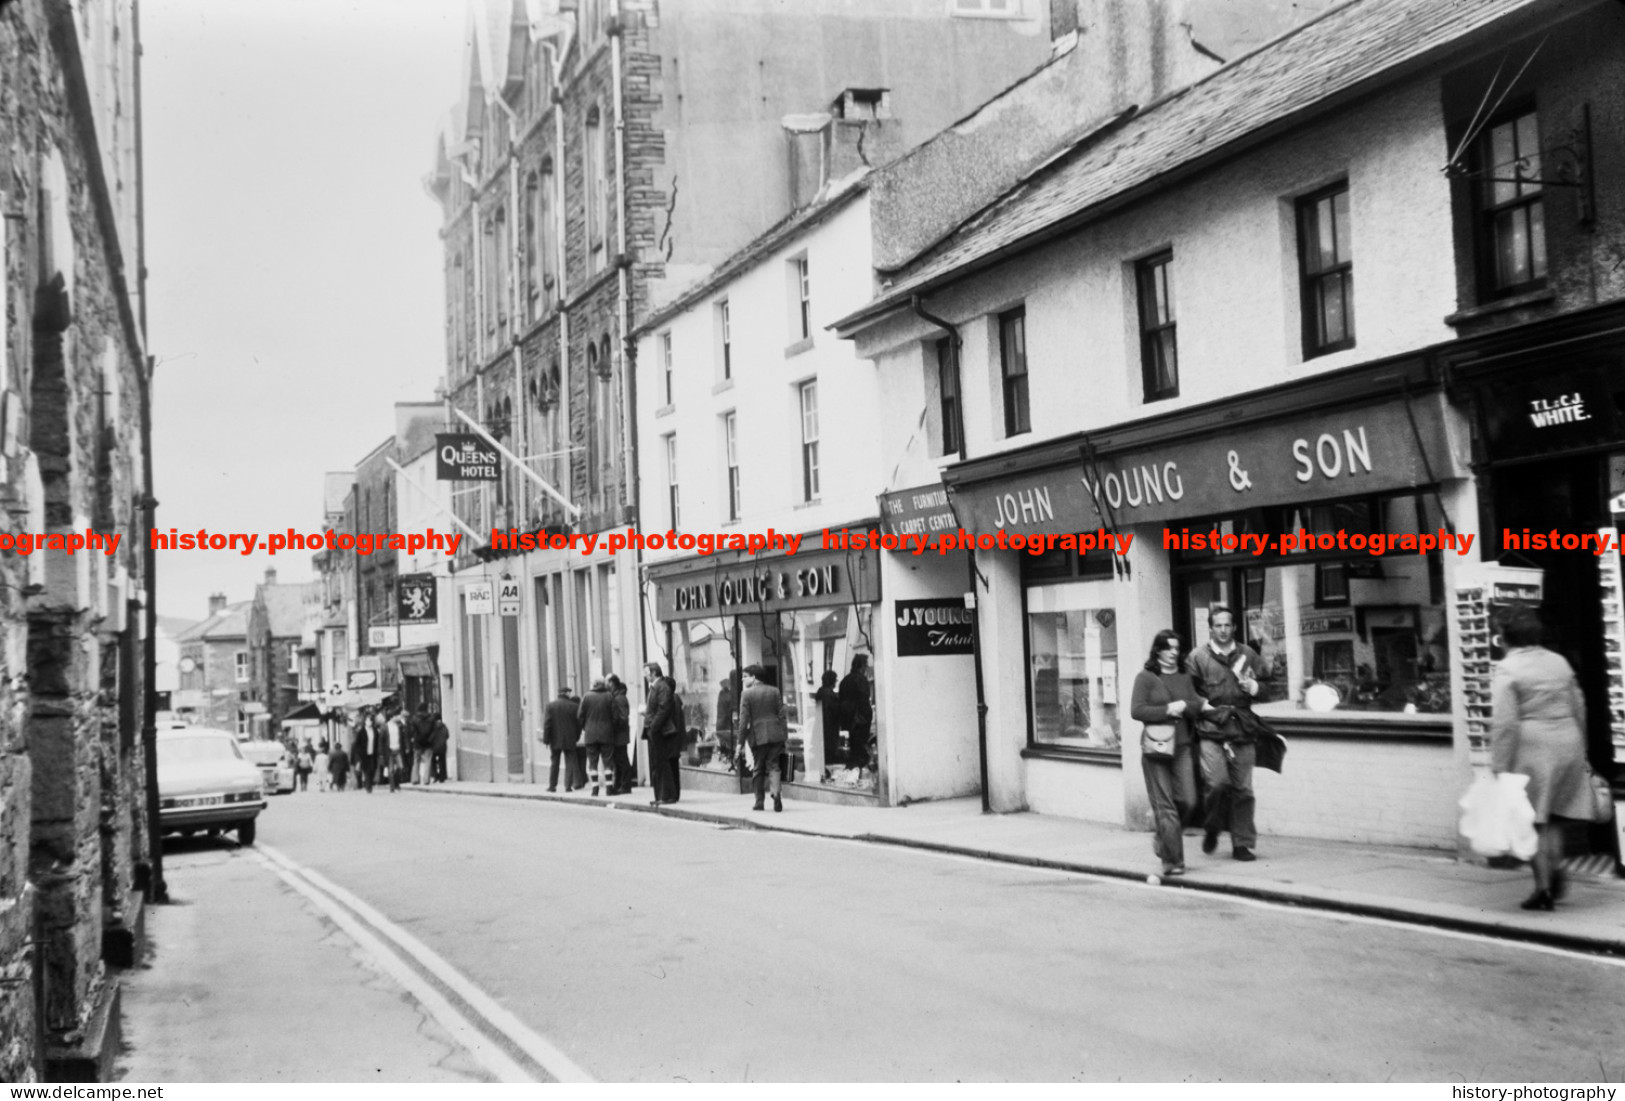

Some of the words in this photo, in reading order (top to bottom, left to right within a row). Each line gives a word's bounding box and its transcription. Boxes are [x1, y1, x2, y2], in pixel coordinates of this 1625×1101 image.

[461, 465, 498, 477] HOTEL
[994, 486, 1054, 528] JOHN
[1081, 461, 1184, 513] YOUNG
[1227, 450, 1252, 491] &
[1292, 426, 1372, 482] SON
[888, 498, 904, 515] THE
[470, 591, 490, 601] RAC
[501, 585, 518, 598] AA
[672, 584, 707, 611] JOHN
[777, 572, 785, 599] &
[796, 565, 833, 597] SON
[927, 630, 975, 647] Furni
